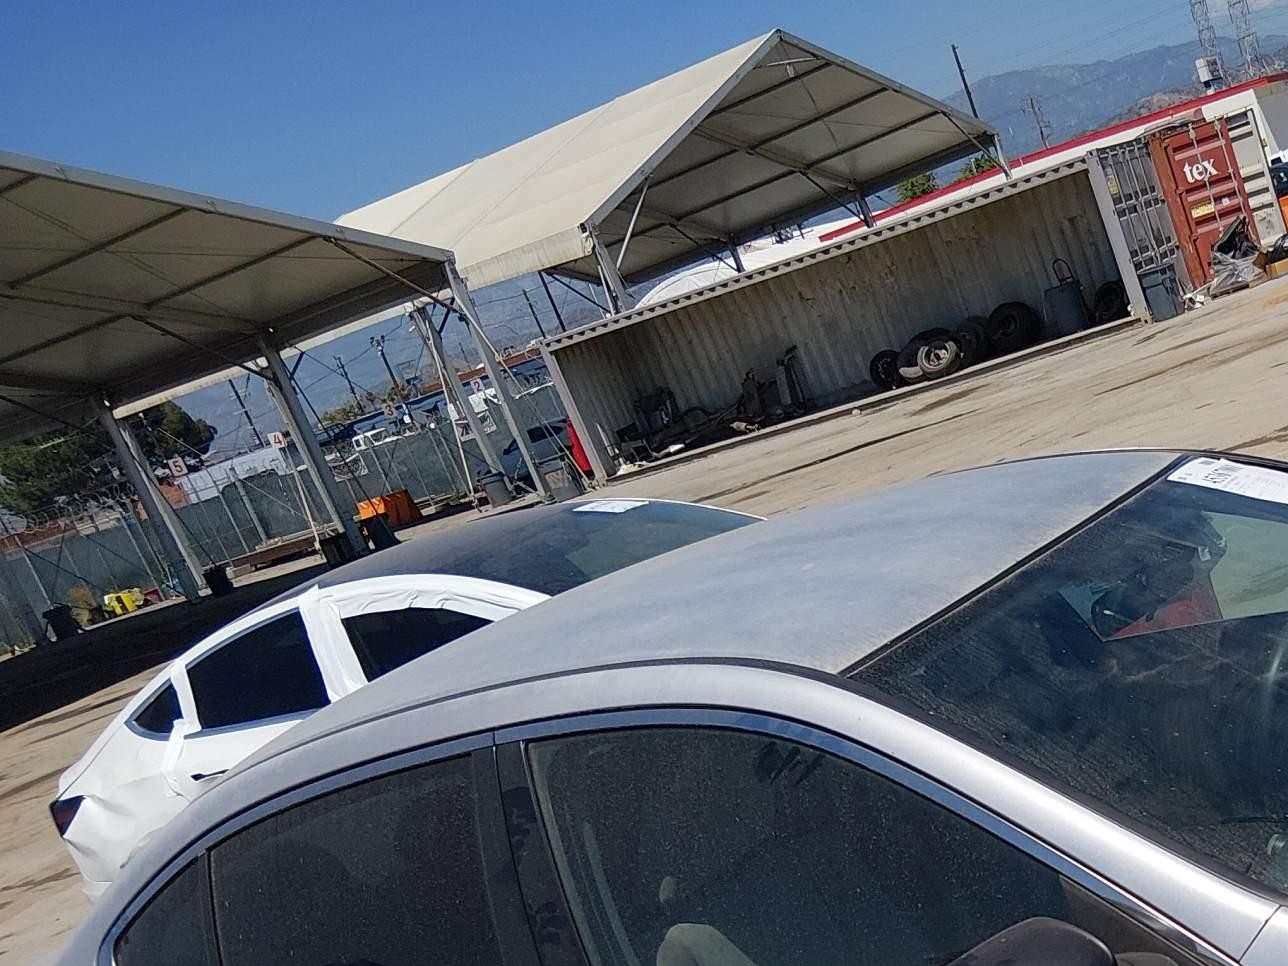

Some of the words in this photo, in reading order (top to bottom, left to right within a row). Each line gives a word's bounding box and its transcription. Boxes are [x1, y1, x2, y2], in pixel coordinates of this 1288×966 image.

[1183, 159, 1219, 183] tex
[473, 381, 483, 392] 2
[385, 404, 393, 416] 3
[273, 434, 282, 446] 4
[172, 460, 183, 473] 5
